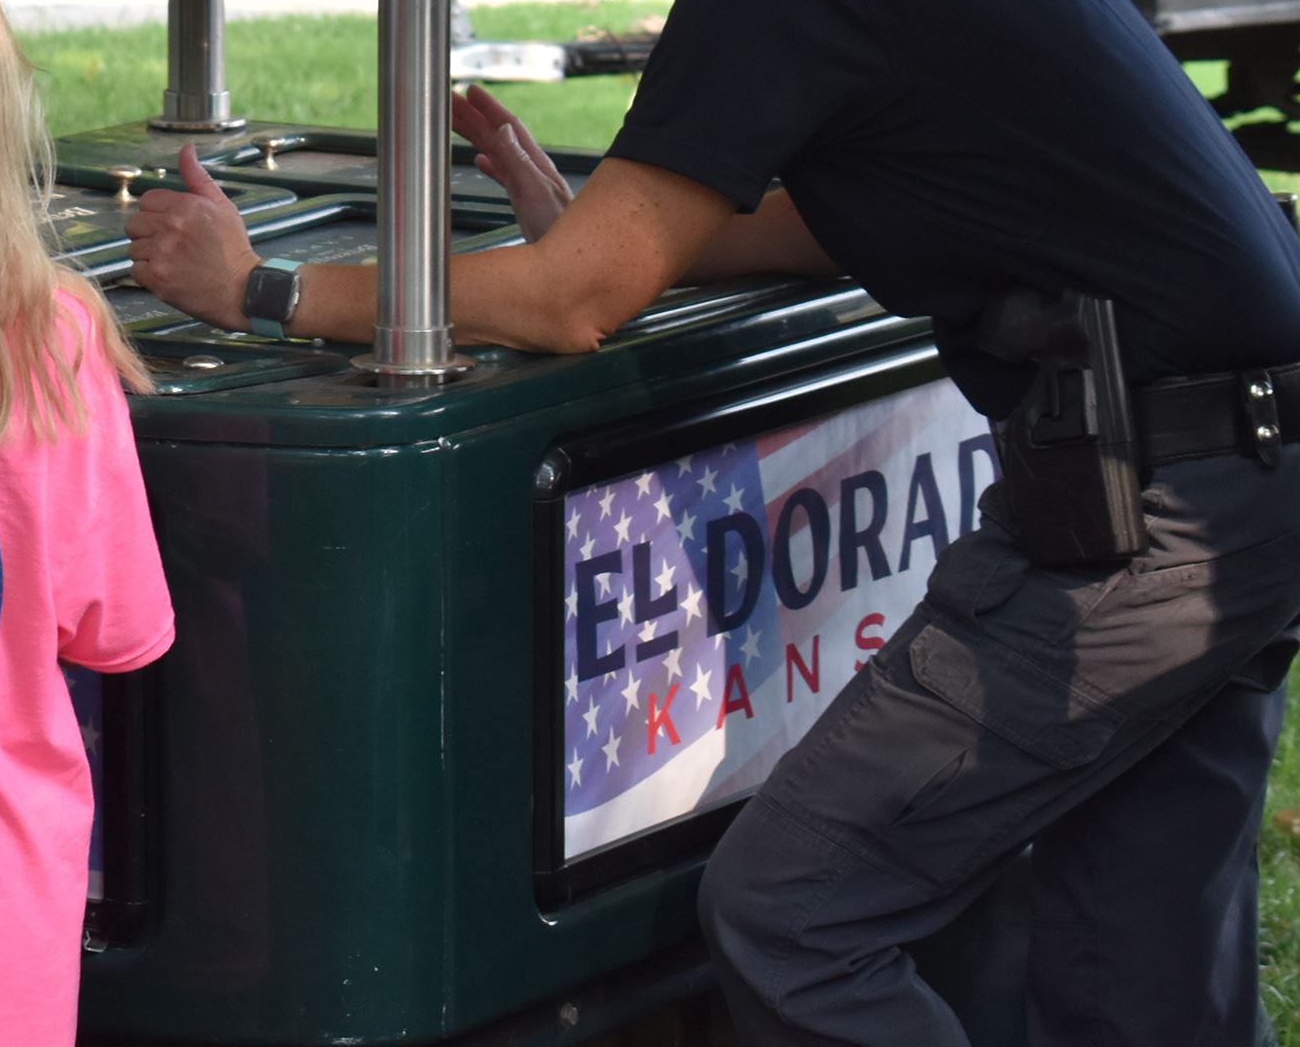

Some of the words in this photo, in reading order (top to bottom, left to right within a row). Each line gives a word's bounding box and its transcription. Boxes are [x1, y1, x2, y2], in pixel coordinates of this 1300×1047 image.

[575, 540, 679, 683] EL
[706, 432, 1001, 637] DORAD
[645, 612, 886, 756] KANS
